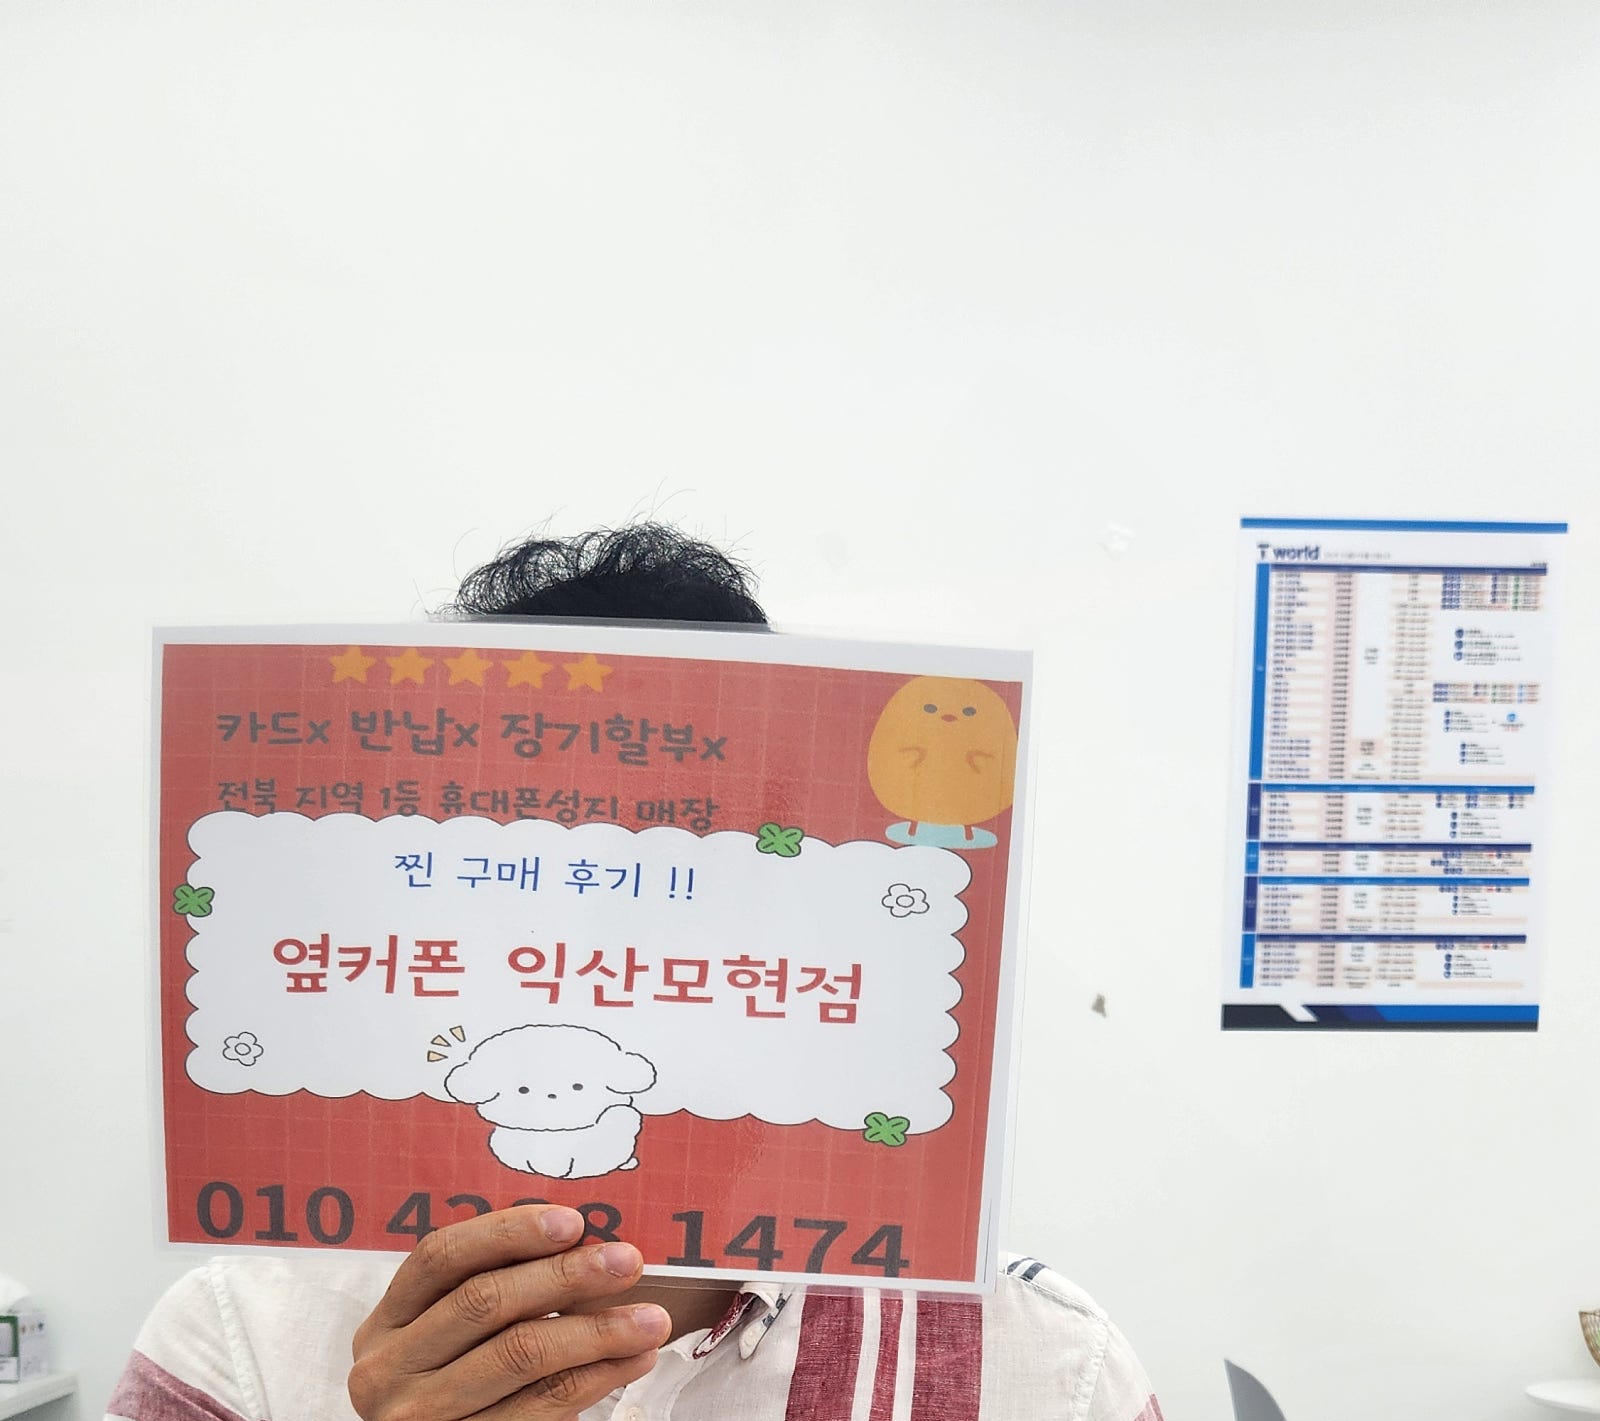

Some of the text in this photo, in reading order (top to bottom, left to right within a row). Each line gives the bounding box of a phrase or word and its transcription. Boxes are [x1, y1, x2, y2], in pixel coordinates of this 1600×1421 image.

[1273, 545, 1320, 561] world
[217, 777, 721, 832] 전북 지역 1등 휴대폰성지 매장
[394, 851, 695, 901] 찐 구매 후기 !!
[272, 932, 863, 1025] 옆커폰 익산모현점
[196, 1181, 355, 1245] 010
[666, 1210, 911, 1279] 1474
